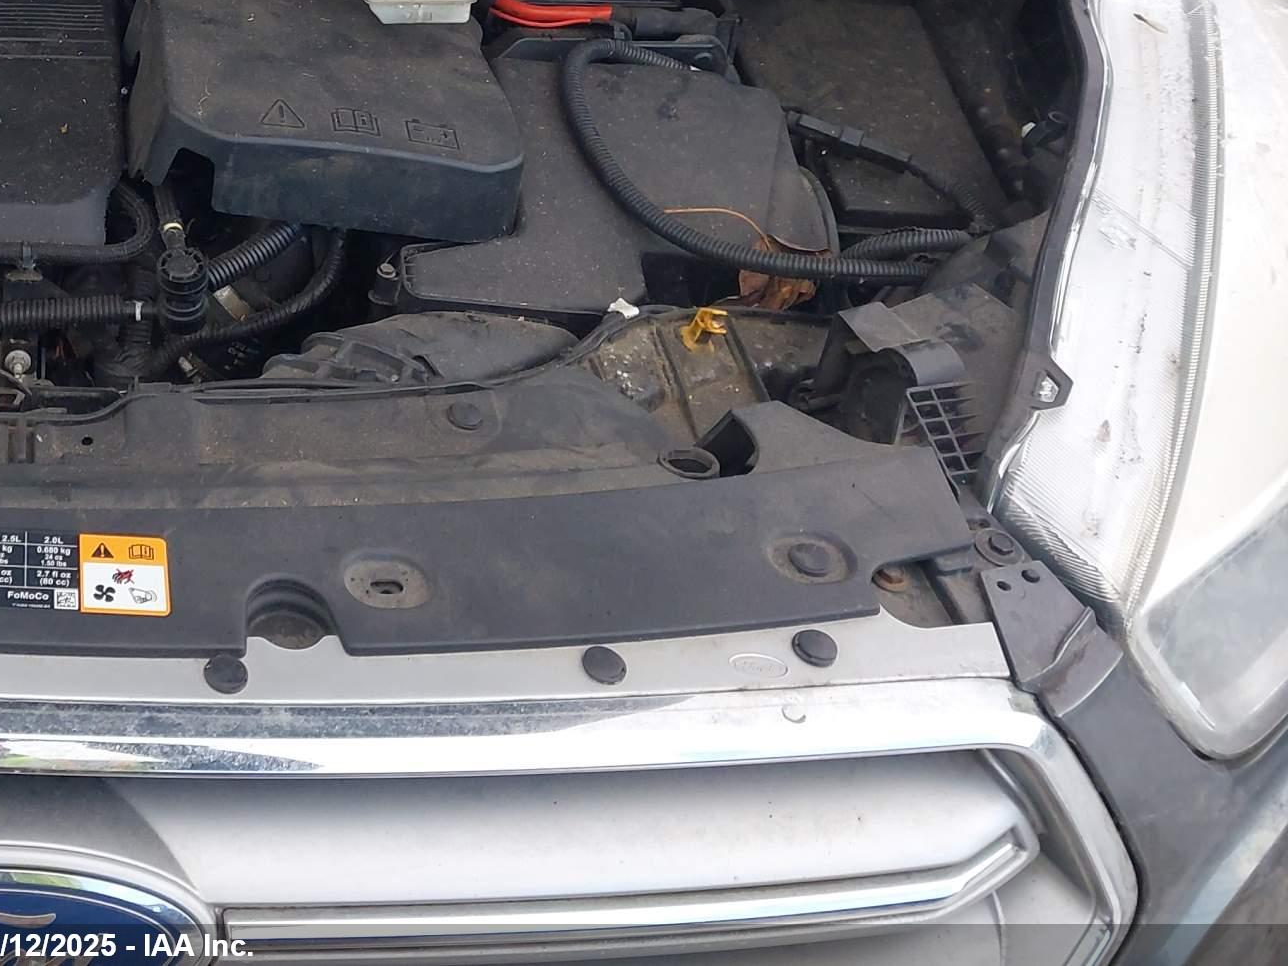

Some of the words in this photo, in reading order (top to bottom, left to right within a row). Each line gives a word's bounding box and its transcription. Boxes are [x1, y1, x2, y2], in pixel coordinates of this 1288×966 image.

[2, 535, 21, 543] 2.5L
[44, 536, 64, 544] 2.0L
[2, 544, 13, 554] kg
[60, 547, 71, 556] kg
[36, 570, 50, 578] 2.7
[55, 579, 70, 587] cc)
[7, 591, 49, 601] FoMoCo
